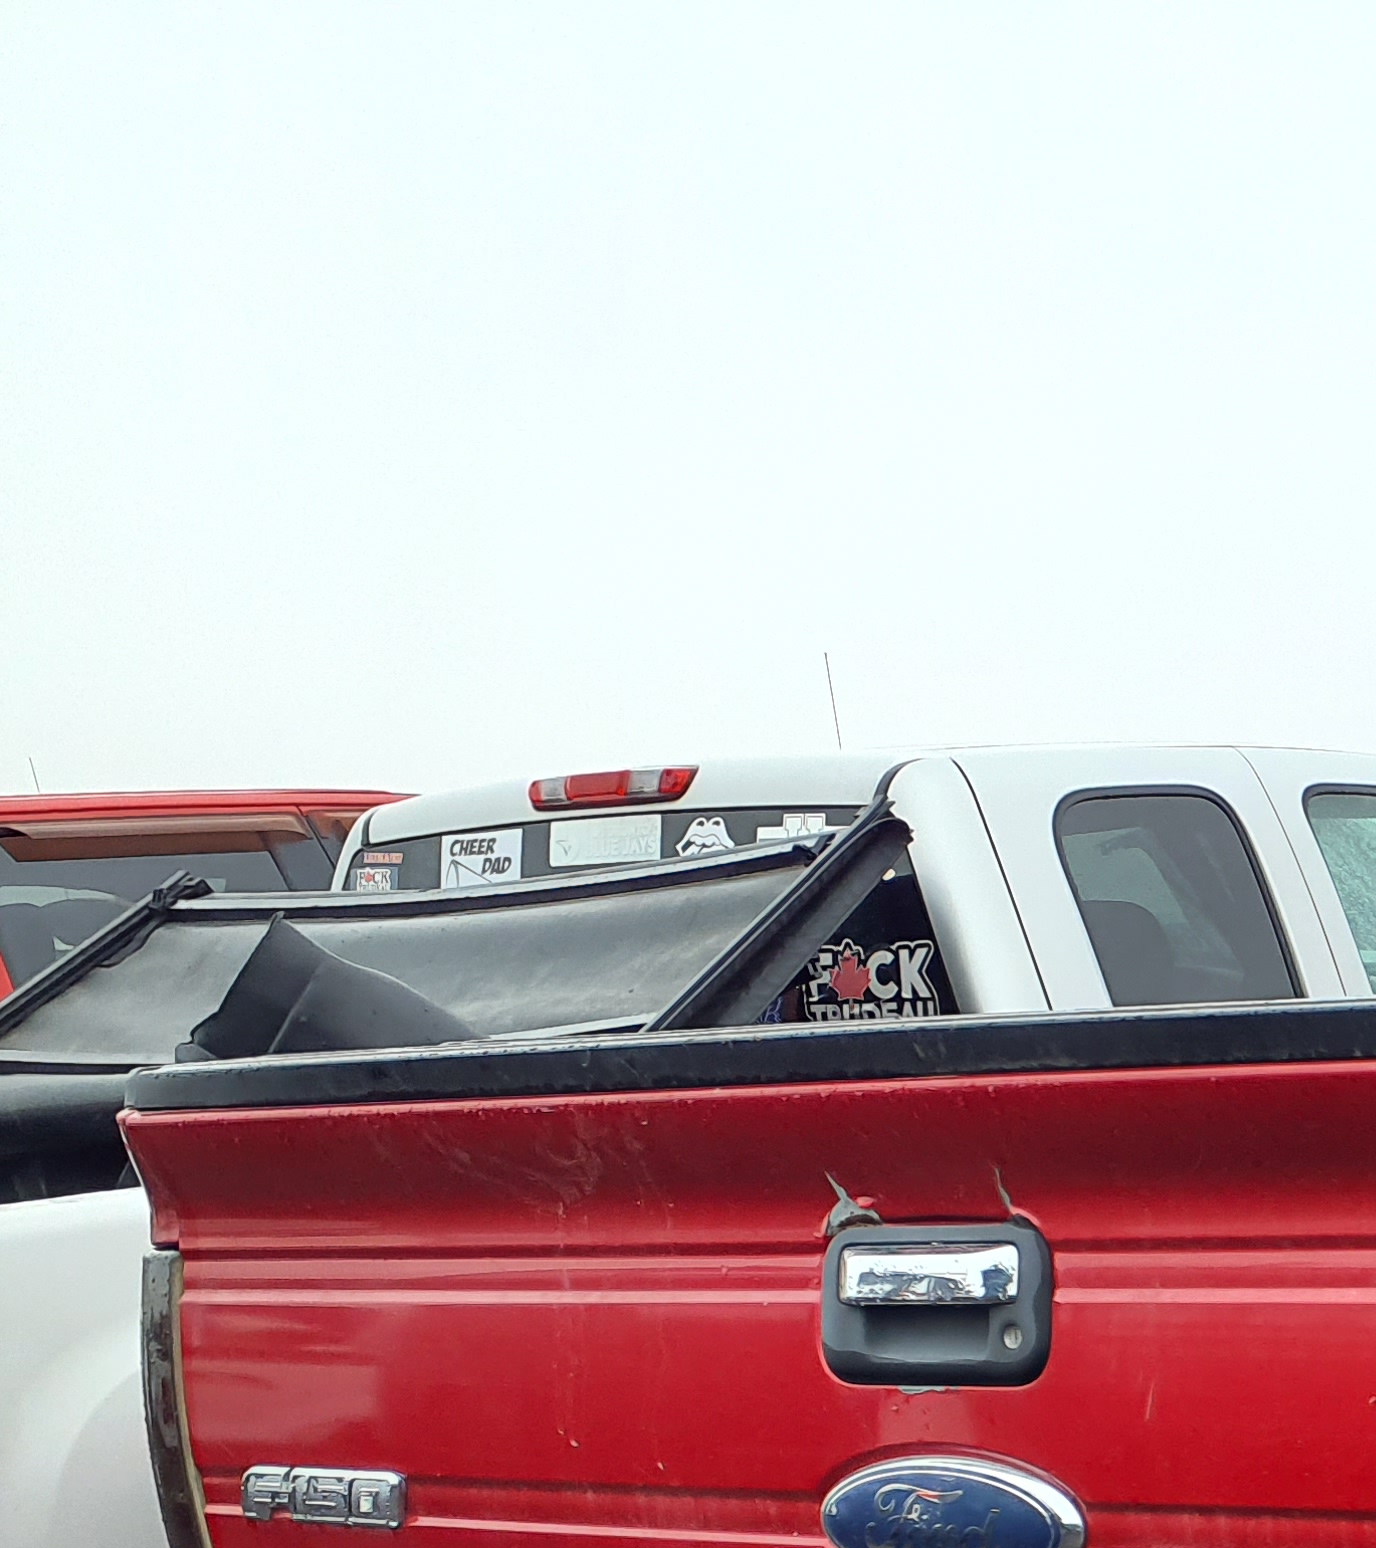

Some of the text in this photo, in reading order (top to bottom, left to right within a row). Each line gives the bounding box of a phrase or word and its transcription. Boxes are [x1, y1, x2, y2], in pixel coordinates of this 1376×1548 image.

[449, 837, 497, 857] CHEER
[481, 856, 512, 876] DAD
[359, 870, 390, 884] FCK
[807, 947, 933, 1003] FCK
